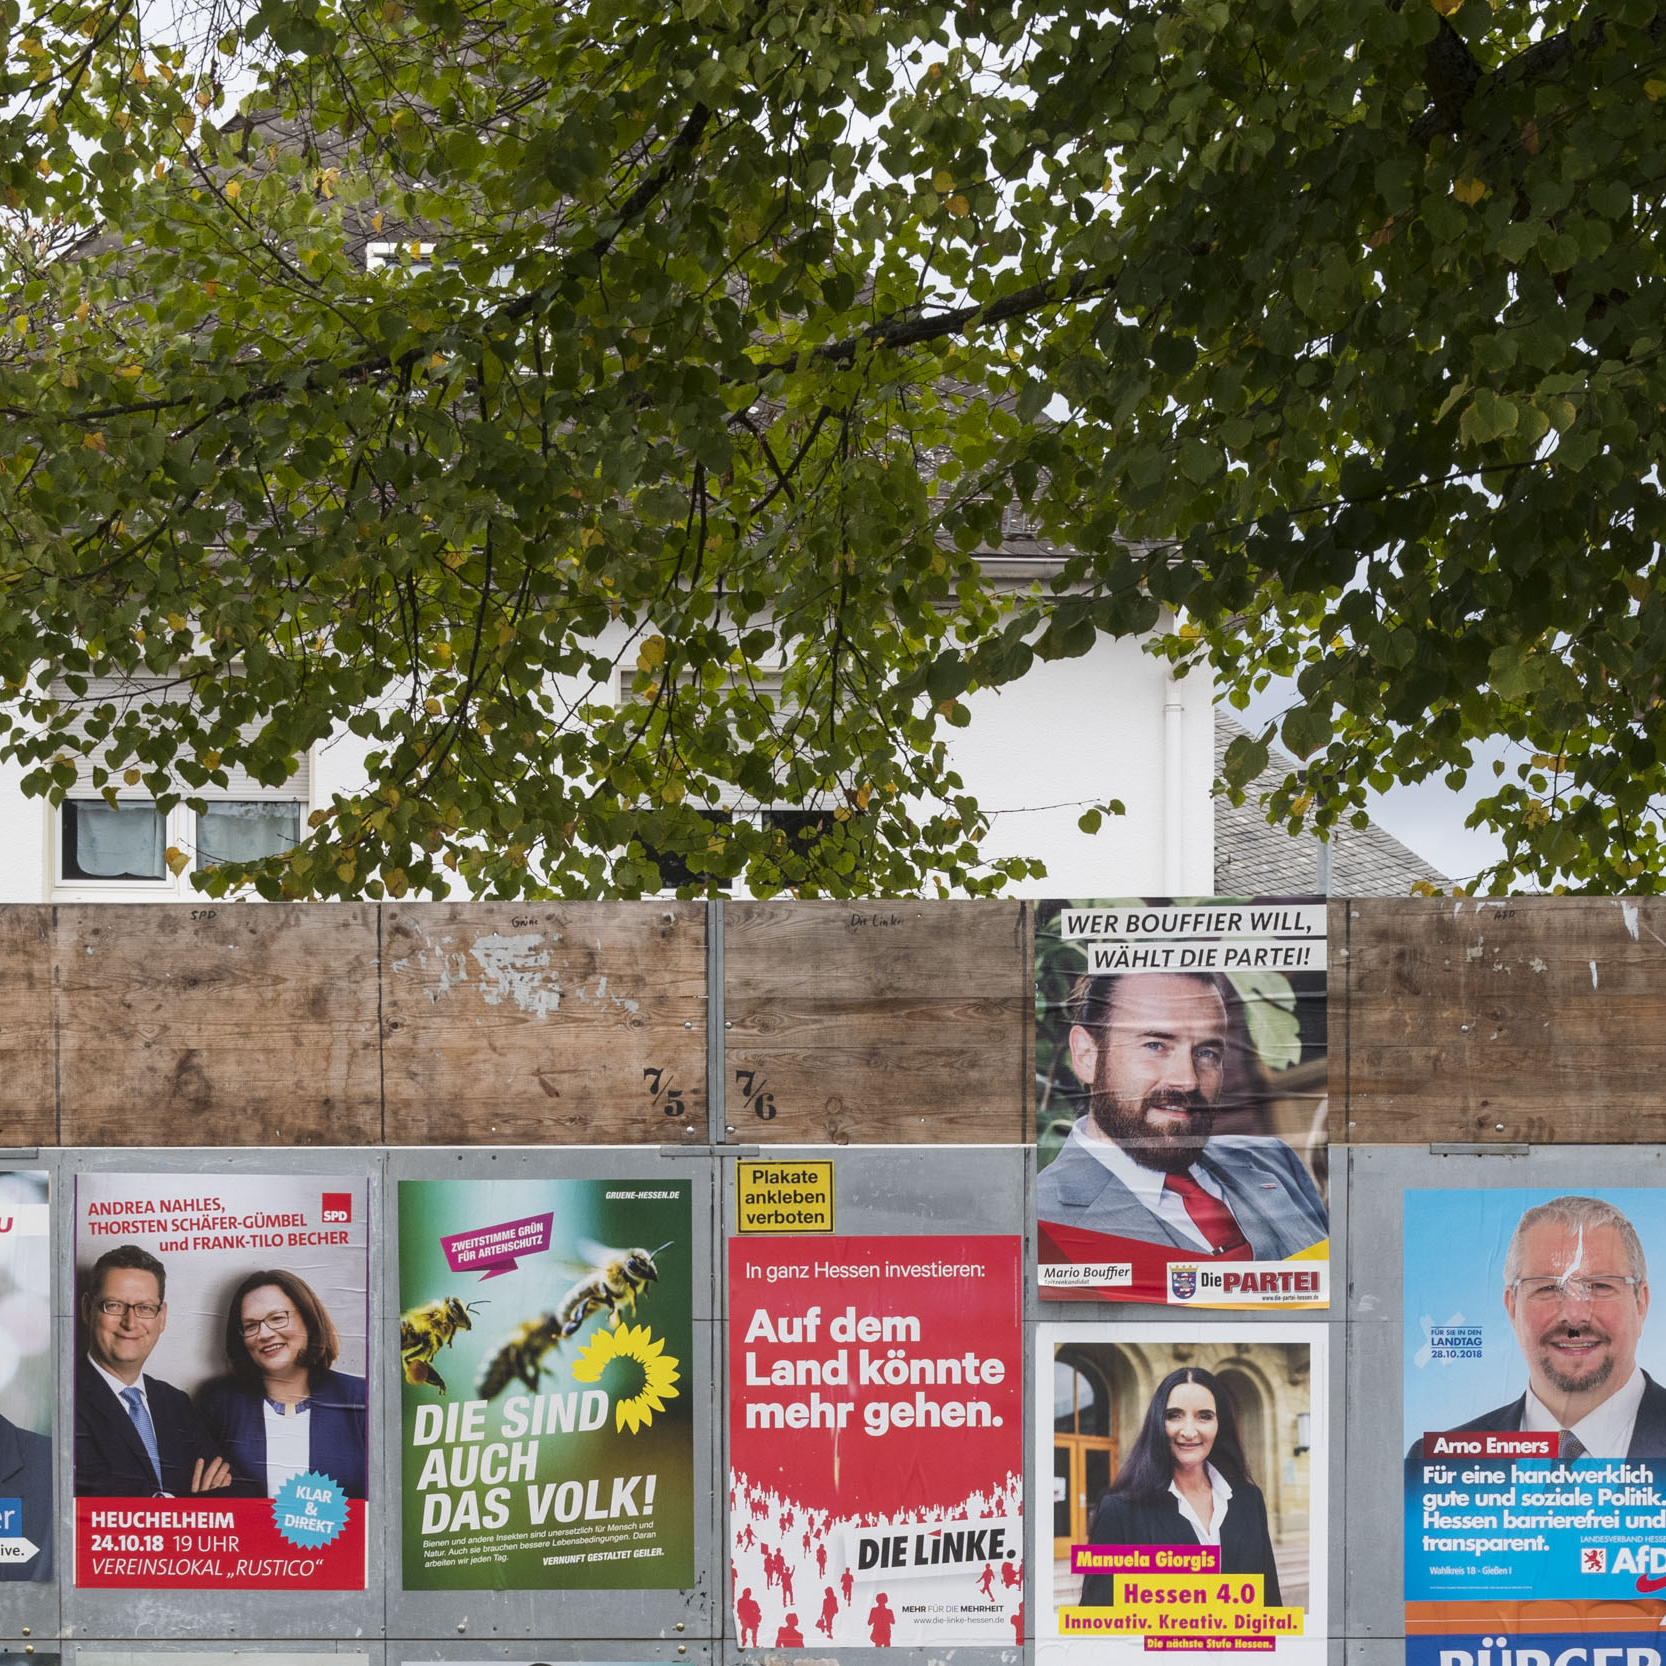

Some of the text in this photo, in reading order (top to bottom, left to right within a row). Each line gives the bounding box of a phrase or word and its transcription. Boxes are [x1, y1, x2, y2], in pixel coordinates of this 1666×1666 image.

[191, 910, 217, 920] SPD
[1068, 911, 1312, 935] WER BOUFFIER WILL,
[1094, 946, 1310, 968] WÄHLT DIE PARTEI!
[752, 1170, 818, 1184] Plakate
[606, 1191, 680, 1200] GRUENE-HESSEN.DE
[745, 1189, 825, 1204] ankleben
[89, 1198, 225, 1216] ANDREA NAHLES,
[323, 1210, 348, 1221] SPD
[746, 1209, 824, 1224] verboten
[89, 1212, 307, 1235] THORSTEN SCHÄFER-GÜMBEL
[159, 1231, 349, 1252] und FRANK-TILO BECHER
[451, 1222, 544, 1252] ZWEITSTIMME GRÜN
[458, 1235, 543, 1263] FÜR ARTENSCHUTZ
[746, 1261, 986, 1283] In ganz Hessen investieren:
[1044, 1266, 1130, 1278] Mario Bouffier
[1201, 1271, 1319, 1293] Die PARTEI
[745, 1306, 920, 1343] Auf dem
[1431, 1338, 1482, 1346] LANDTAG
[1431, 1350, 1482, 1358] 28.10.2018
[746, 1349, 1005, 1385] Land könnte
[412, 1390, 609, 1446] DIE SIND
[746, 1392, 1003, 1436] mehr gehen.
[1433, 1438, 1549, 1454] Arno Enners
[416, 1441, 539, 1490] AUCH
[1423, 1465, 1653, 1484] Für eine handwerklich
[296, 1486, 332, 1503] KLAR
[421, 1474, 657, 1535] DAS VOLK!
[1422, 1490, 1470, 1511] gute
[1474, 1488, 1517, 1506] und
[1520, 1488, 1593, 1506] soziale
[91, 1512, 234, 1528] HEUCHELHEIM
[284, 1515, 335, 1533] DIREKT
[1423, 1510, 1666, 1529] Hessen barrierefrei und
[91, 1535, 240, 1552] 24.10.18 19 UHR
[423, 1540, 449, 1548] Bienen
[468, 1535, 494, 1544] andere
[496, 1532, 528, 1542] Insekten
[595, 1525, 605, 1533] für
[608, 1522, 636, 1532] Mensch
[639, 1521, 653, 1529] und
[858, 1535, 907, 1570] DIE
[1422, 1535, 1550, 1557] transparent.
[543, 1547, 664, 1566] VERNUNFT GESTALTET GEILER.
[1076, 1551, 1215, 1571] Manuela Giorgis
[91, 1559, 223, 1576] VEREINSLOKAL
[1124, 1583, 1255, 1604] Hessen 4.0
[1064, 1614, 1297, 1634] Innovativ. Kreativ. Digital.
